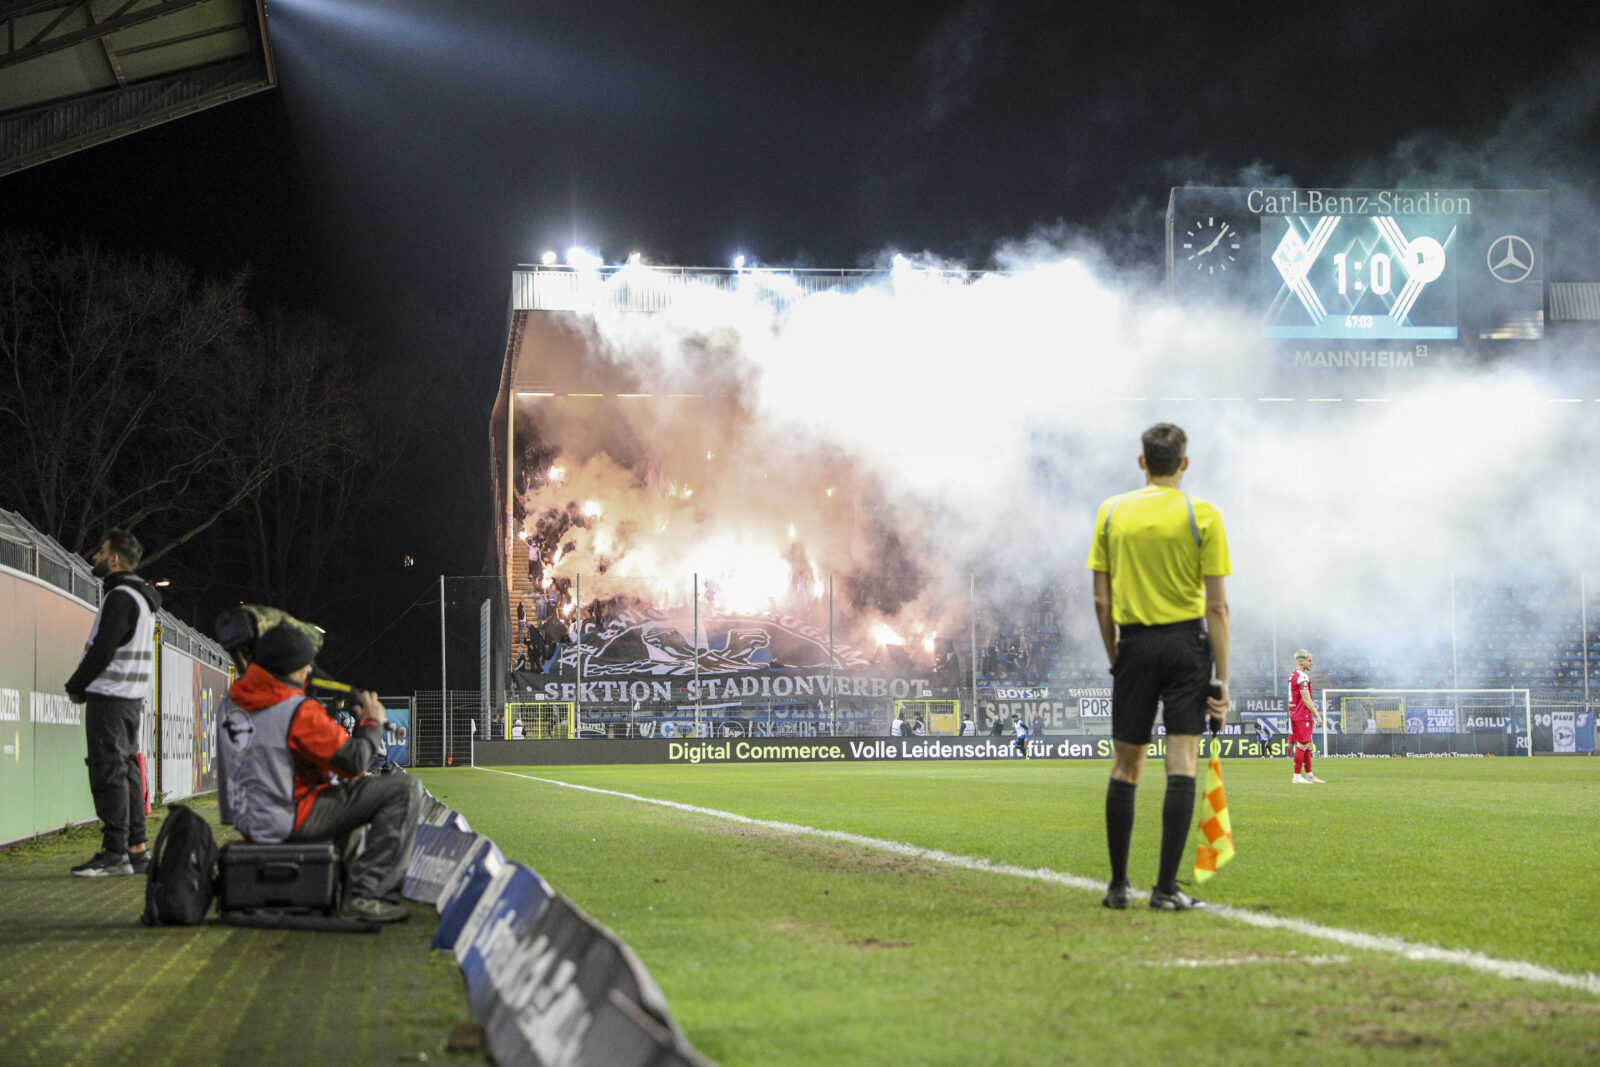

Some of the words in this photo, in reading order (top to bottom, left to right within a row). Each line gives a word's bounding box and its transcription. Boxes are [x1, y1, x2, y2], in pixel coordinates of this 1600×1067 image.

[1247, 189, 1472, 215] Carl-Benz-Stadion
[1333, 252, 1391, 296] 1:0
[1293, 351, 1415, 368] MANNHEIM
[544, 680, 672, 702] SEKTION
[687, 675, 929, 702] STADIONVERBOT
[996, 688, 1034, 699] BOYS
[985, 701, 1064, 728] SPENGE
[1247, 700, 1285, 711] HALLE
[1427, 708, 1455, 717] BLOCK
[1427, 717, 1455, 727] ZWO
[668, 741, 731, 763] Digital
[736, 741, 846, 760] Commerce.
[849, 740, 897, 759] Volle
[902, 739, 1022, 759] Leidenschaft
[1026, 738, 1054, 758] für
[1057, 739, 1093, 757] den
